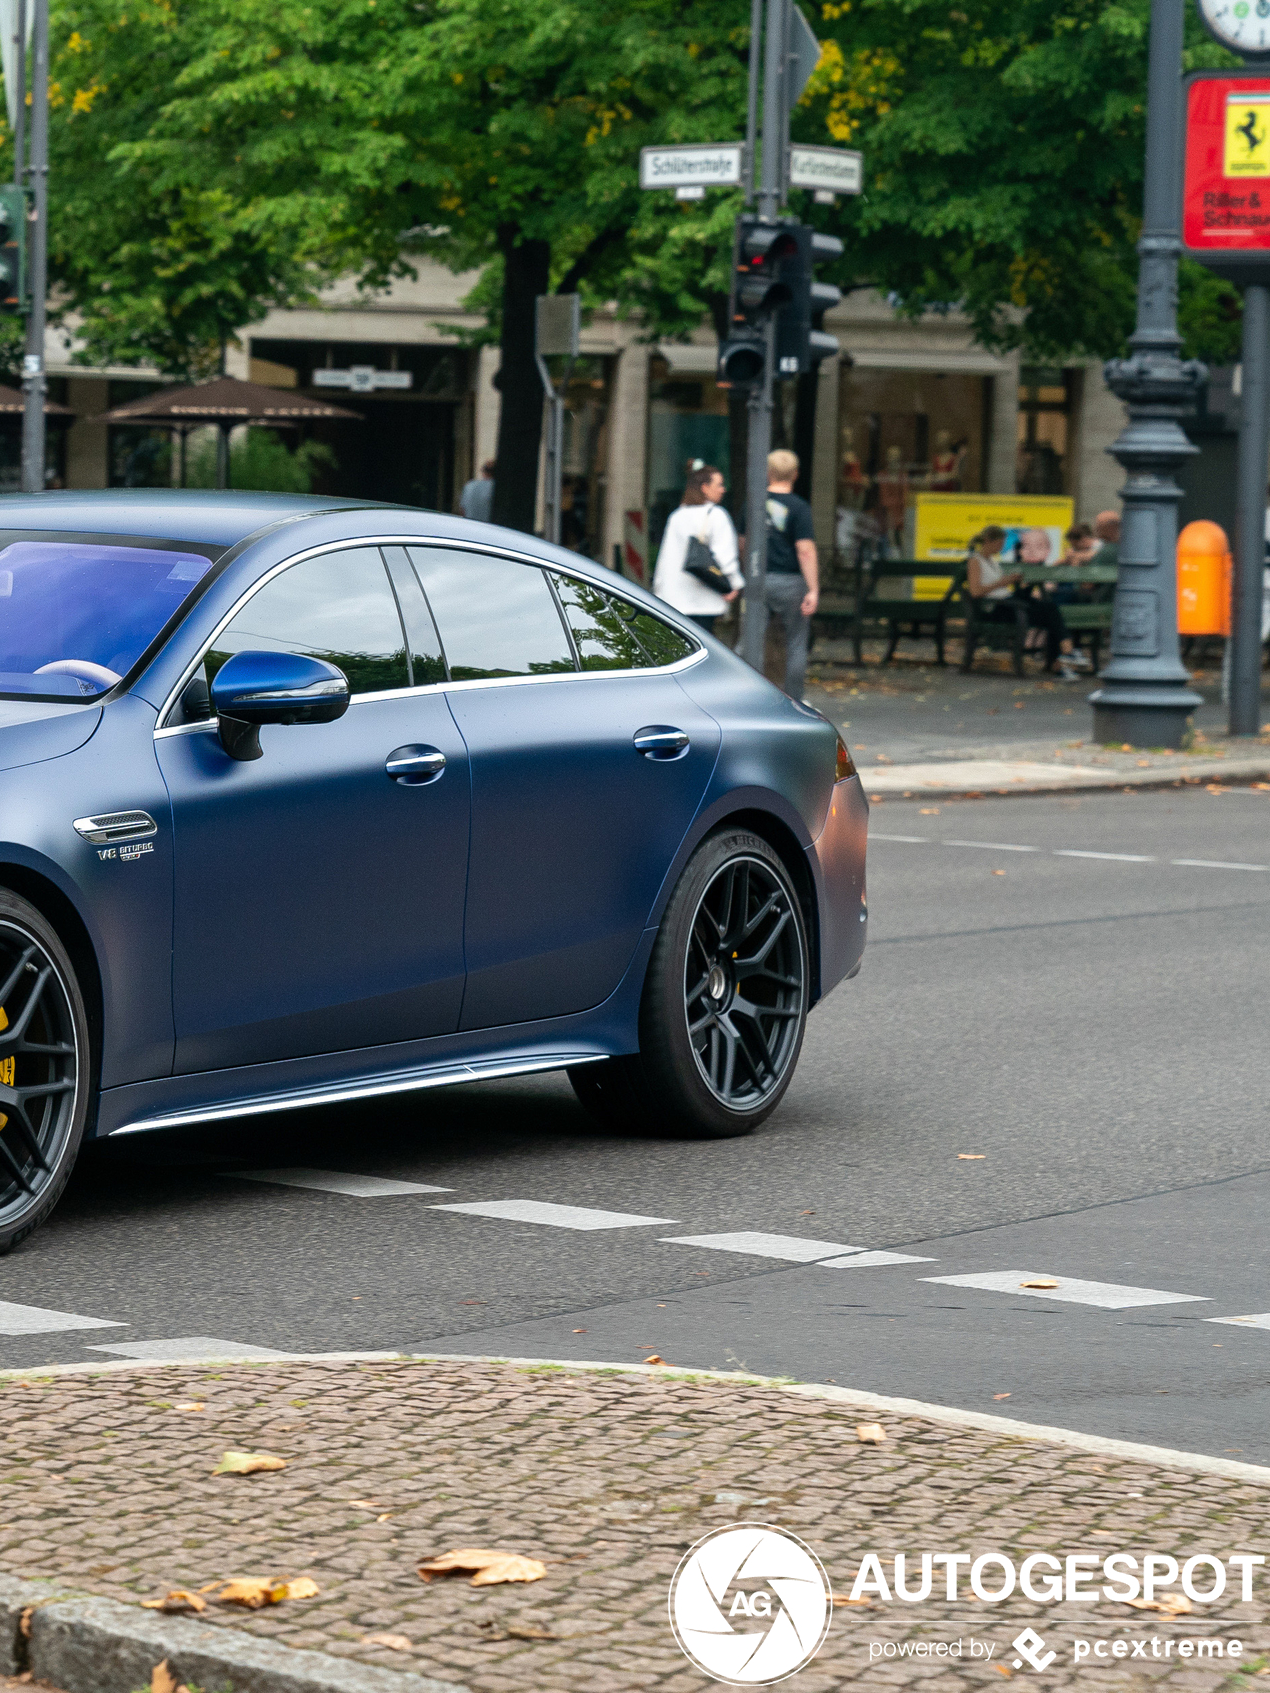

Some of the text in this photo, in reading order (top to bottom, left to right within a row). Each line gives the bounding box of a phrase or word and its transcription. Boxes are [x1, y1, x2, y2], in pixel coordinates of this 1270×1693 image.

[651, 154, 733, 177] Schlüterstraße
[1248, 191, 1261, 208] &
[96, 848, 116, 861] V8
[119, 842, 154, 853] BITURBO
